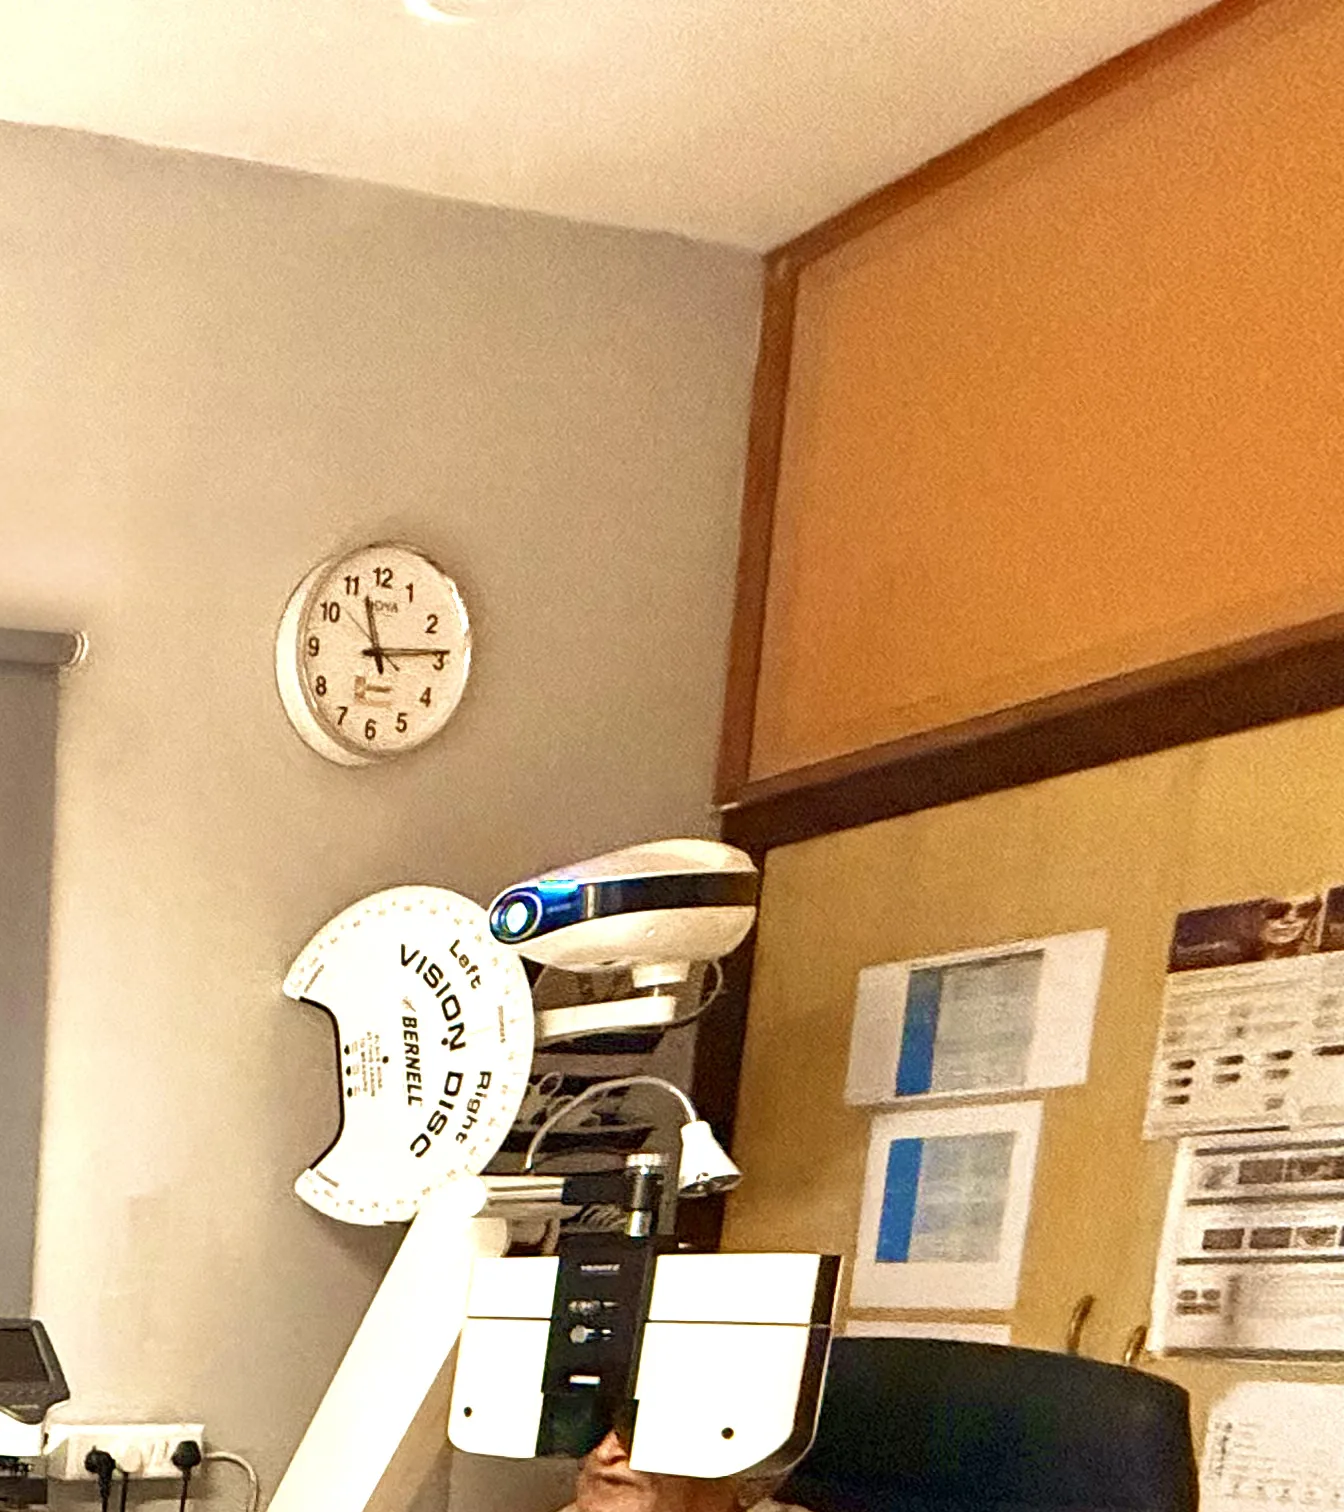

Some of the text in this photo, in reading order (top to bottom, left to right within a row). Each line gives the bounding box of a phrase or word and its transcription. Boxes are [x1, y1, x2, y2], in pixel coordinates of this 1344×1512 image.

[344, 575, 359, 595] 11
[373, 567, 393, 589] 12
[406, 583, 413, 602] 1
[320, 601, 340, 622] 10
[425, 614, 438, 634] 2
[308, 636, 320, 656] 9
[432, 652, 445, 671] 3
[316, 675, 327, 696] 8
[420, 687, 431, 707] 4
[337, 706, 348, 725] 7
[395, 712, 408, 733] 5
[365, 718, 376, 740] 6
[449, 939, 481, 990] Left
[401, 944, 467, 1158] VISION DISC
[402, 1015, 423, 1106] BERNELL
[455, 1070, 492, 1144] Right
